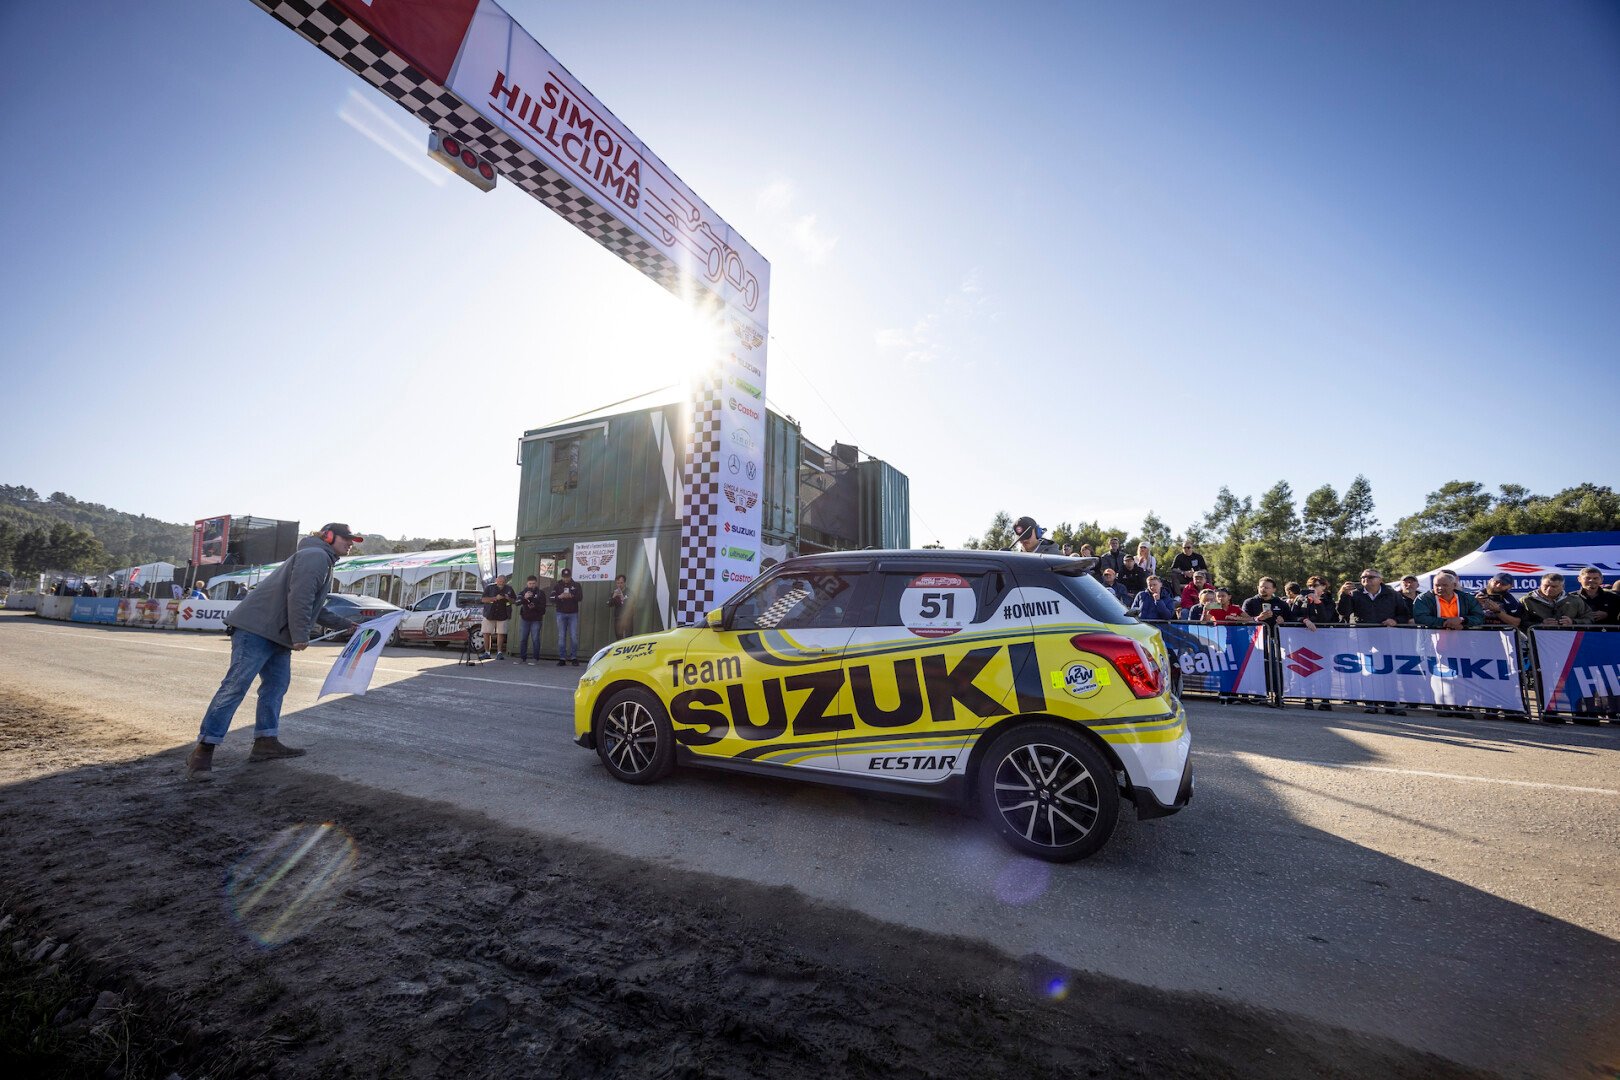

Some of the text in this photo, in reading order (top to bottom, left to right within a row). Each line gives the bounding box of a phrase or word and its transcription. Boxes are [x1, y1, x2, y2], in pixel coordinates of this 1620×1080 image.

[489, 70, 640, 209] HILLCLIMB
[541, 82, 641, 187] SIMOLA
[737, 403, 760, 420] Castrol
[731, 525, 756, 537] SUZUKI
[195, 609, 233, 619] SUZU
[919, 592, 955, 619] 51
[1003, 600, 1060, 620] #OWNIT
[441, 608, 470, 624] Turbo
[613, 642, 658, 656] SWIFT
[624, 649, 655, 661] Sport
[668, 655, 742, 688] Team
[1333, 653, 1510, 681] SUZUKI
[1573, 663, 1620, 698] HI
[670, 642, 1047, 746] SUZUKI
[869, 756, 957, 770] ECSTAR
